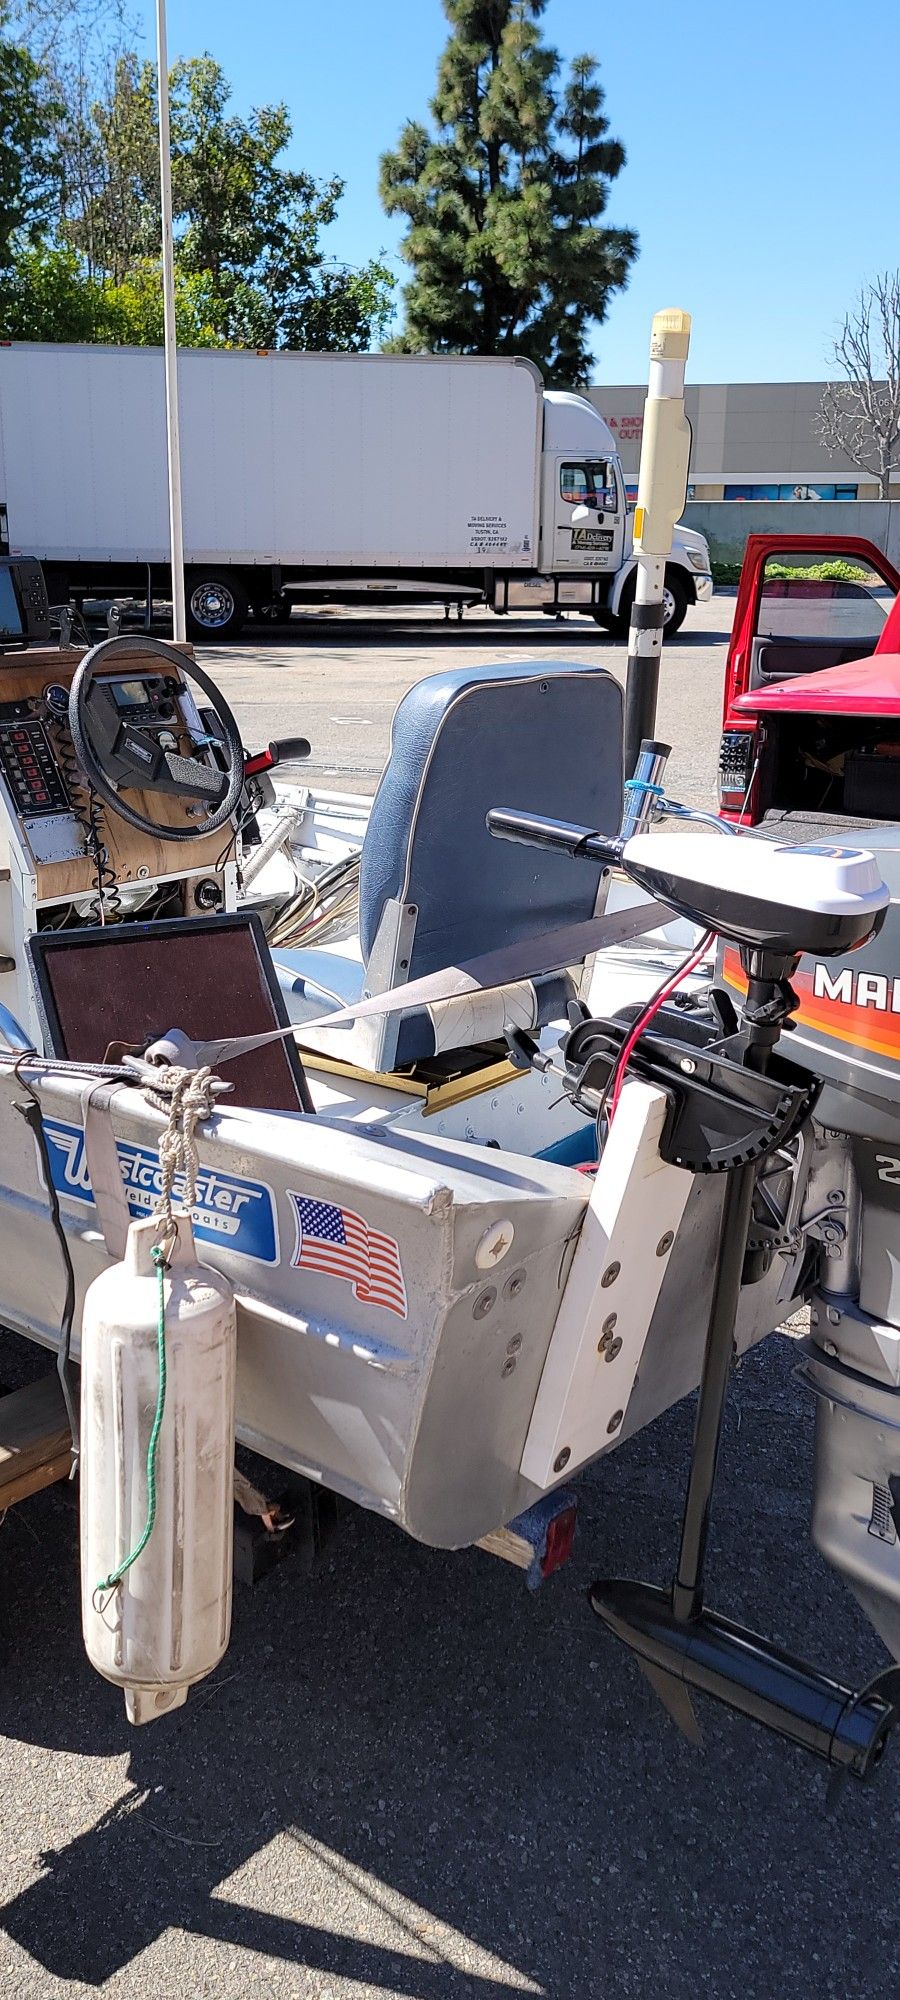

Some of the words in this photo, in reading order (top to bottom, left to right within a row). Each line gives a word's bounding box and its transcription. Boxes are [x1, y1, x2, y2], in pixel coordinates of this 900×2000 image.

[622, 416, 643, 427] SHO
[573, 528, 587, 540] TA
[587, 533, 612, 543] Delivery
[42, 1126, 262, 1215] Wstcoaster
